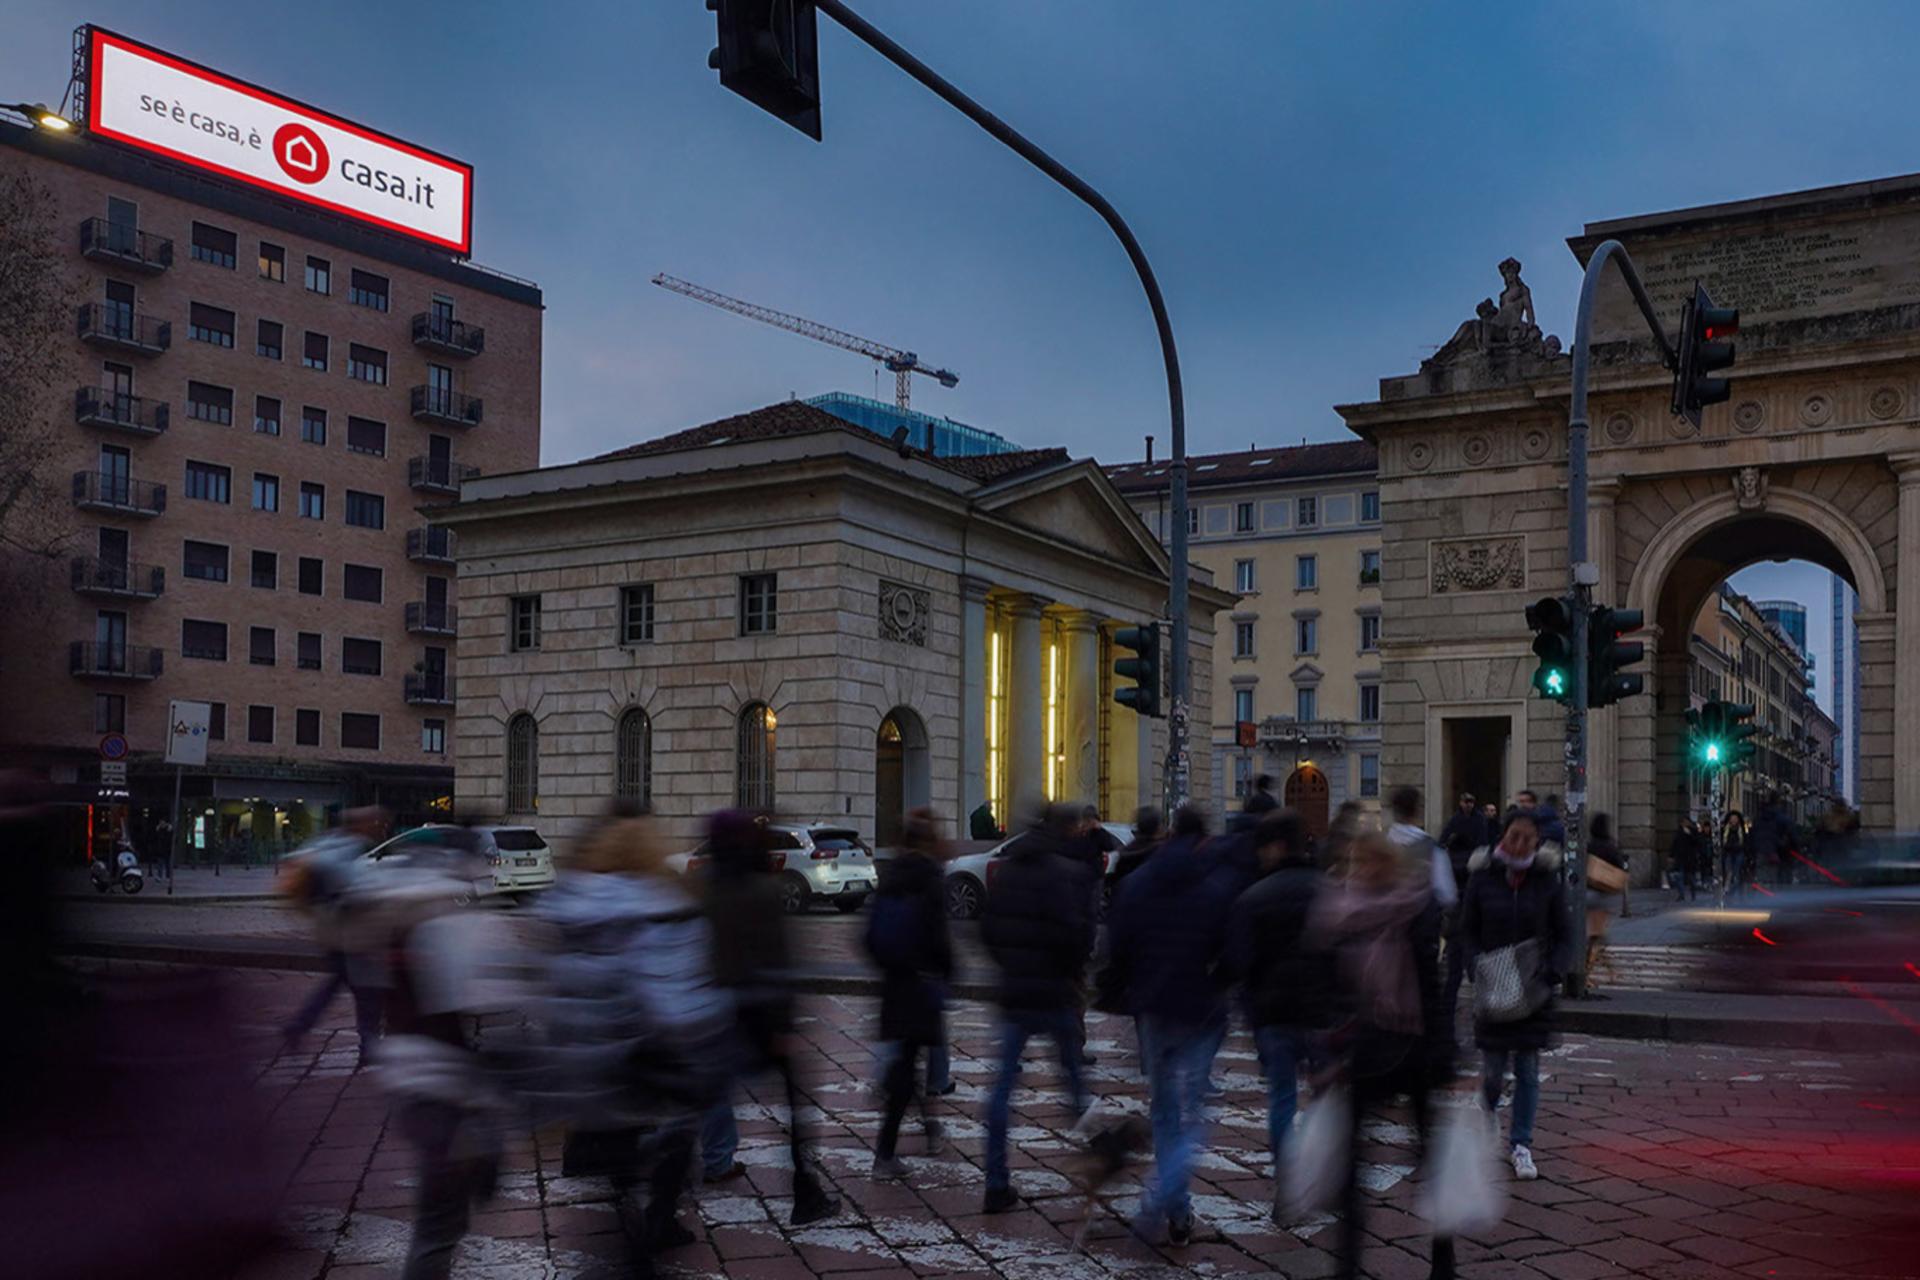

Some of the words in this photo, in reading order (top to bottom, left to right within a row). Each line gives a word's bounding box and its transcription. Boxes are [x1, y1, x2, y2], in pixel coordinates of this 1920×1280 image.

[141, 94, 167, 118] se
[172, 101, 185, 123] è
[190, 112, 245, 146] casa,
[248, 128, 262, 150] è
[340, 158, 435, 210] casa.it
